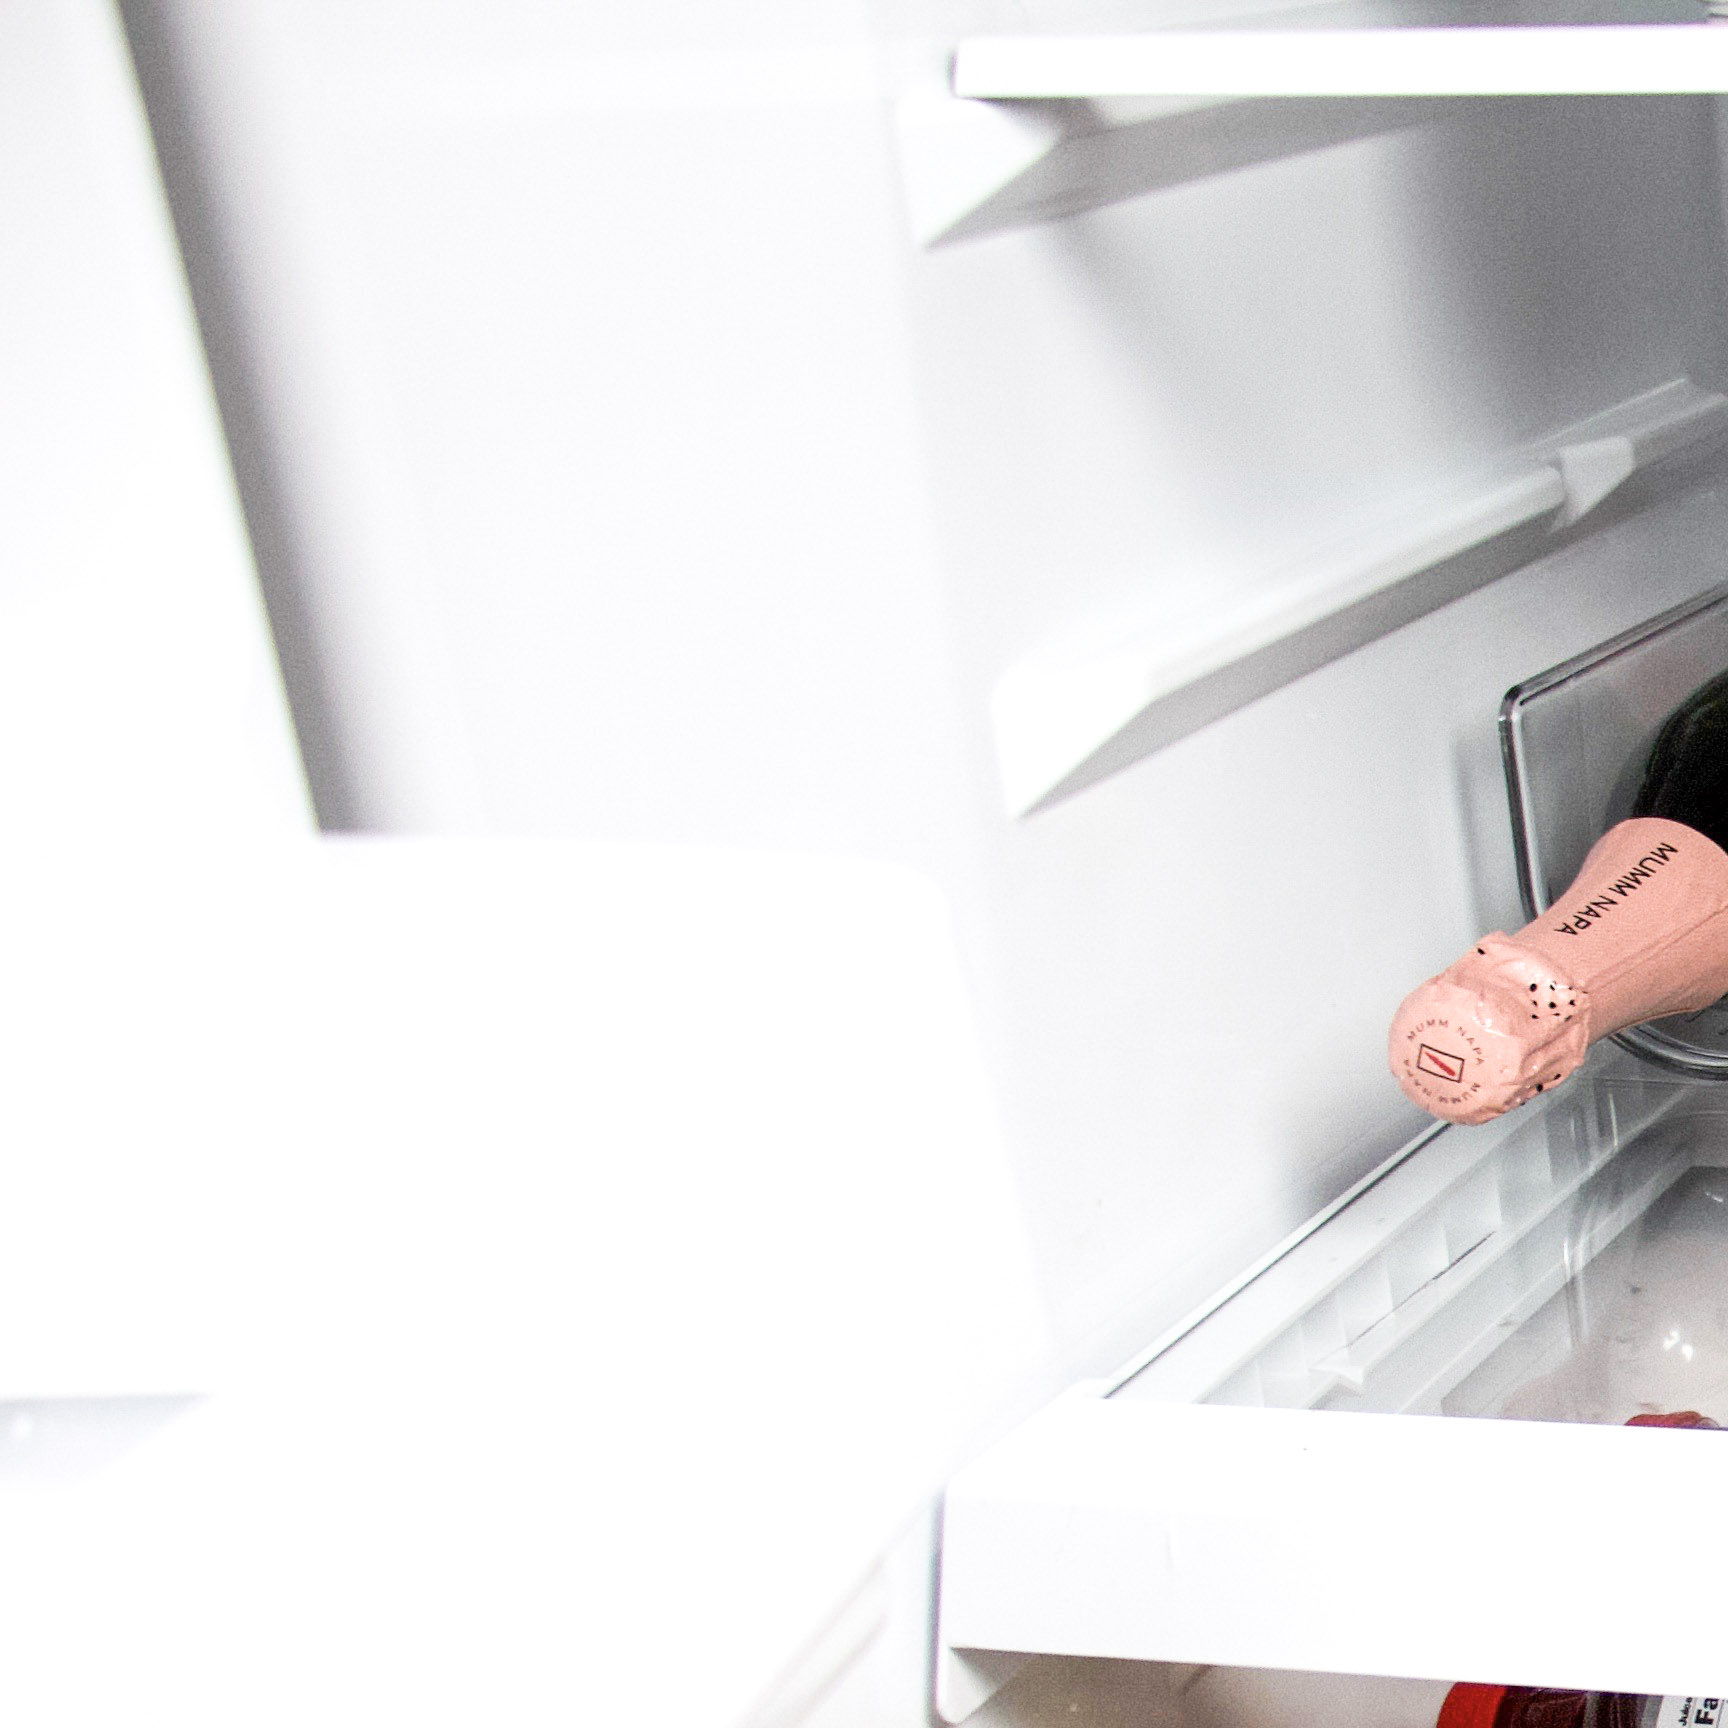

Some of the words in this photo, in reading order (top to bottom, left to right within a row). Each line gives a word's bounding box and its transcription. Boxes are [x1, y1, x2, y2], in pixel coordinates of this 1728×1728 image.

[1609, 842, 1679, 897] MUMM
[1554, 896, 1619, 936] NAPA
[1406, 1018, 1450, 1042] MUMM
[1457, 1025, 1485, 1066] NAPA
